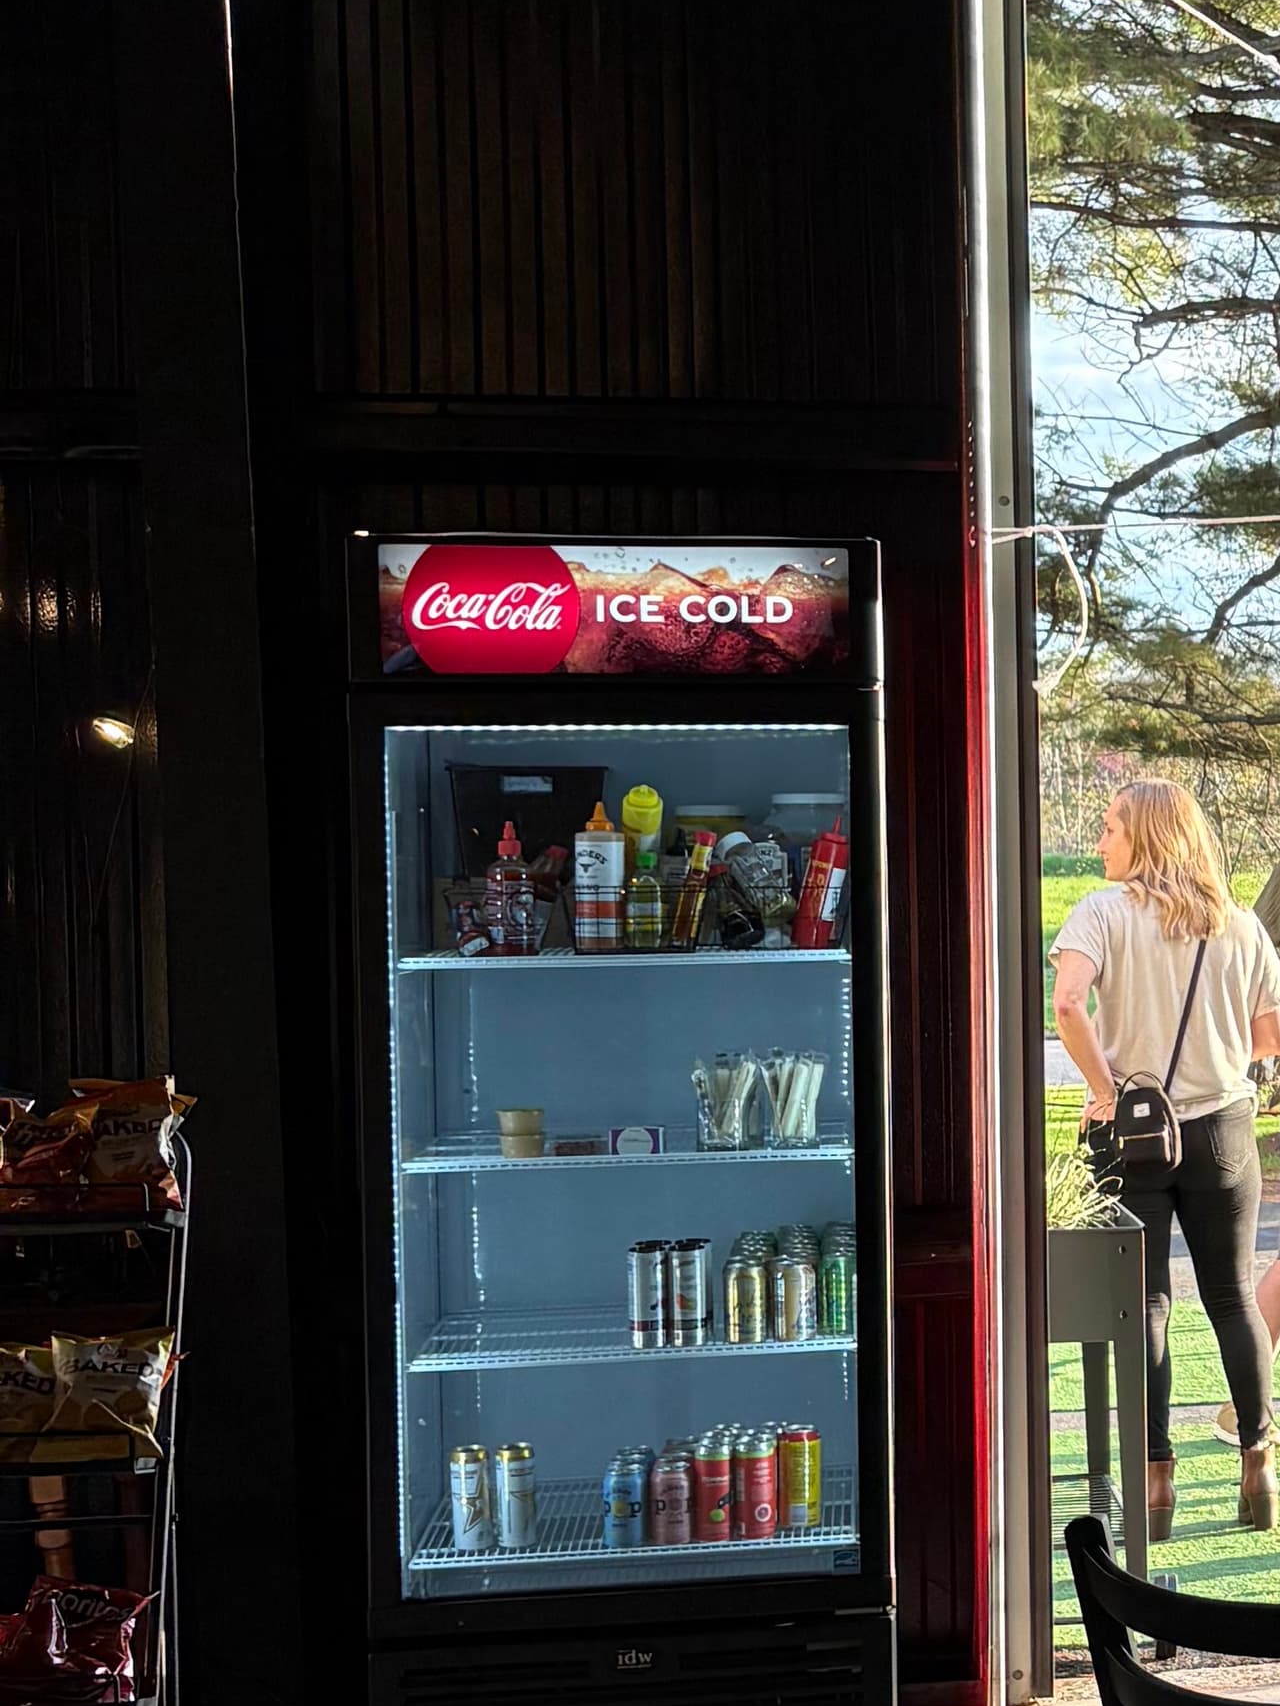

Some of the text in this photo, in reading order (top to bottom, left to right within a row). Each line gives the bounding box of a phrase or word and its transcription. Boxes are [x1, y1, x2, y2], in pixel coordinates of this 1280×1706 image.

[411, 581, 571, 631] Coca-Cola
[596, 594, 793, 624] ICE COLD
[60, 1359, 154, 1376] BAKED
[616, 1649, 653, 1666] idw
